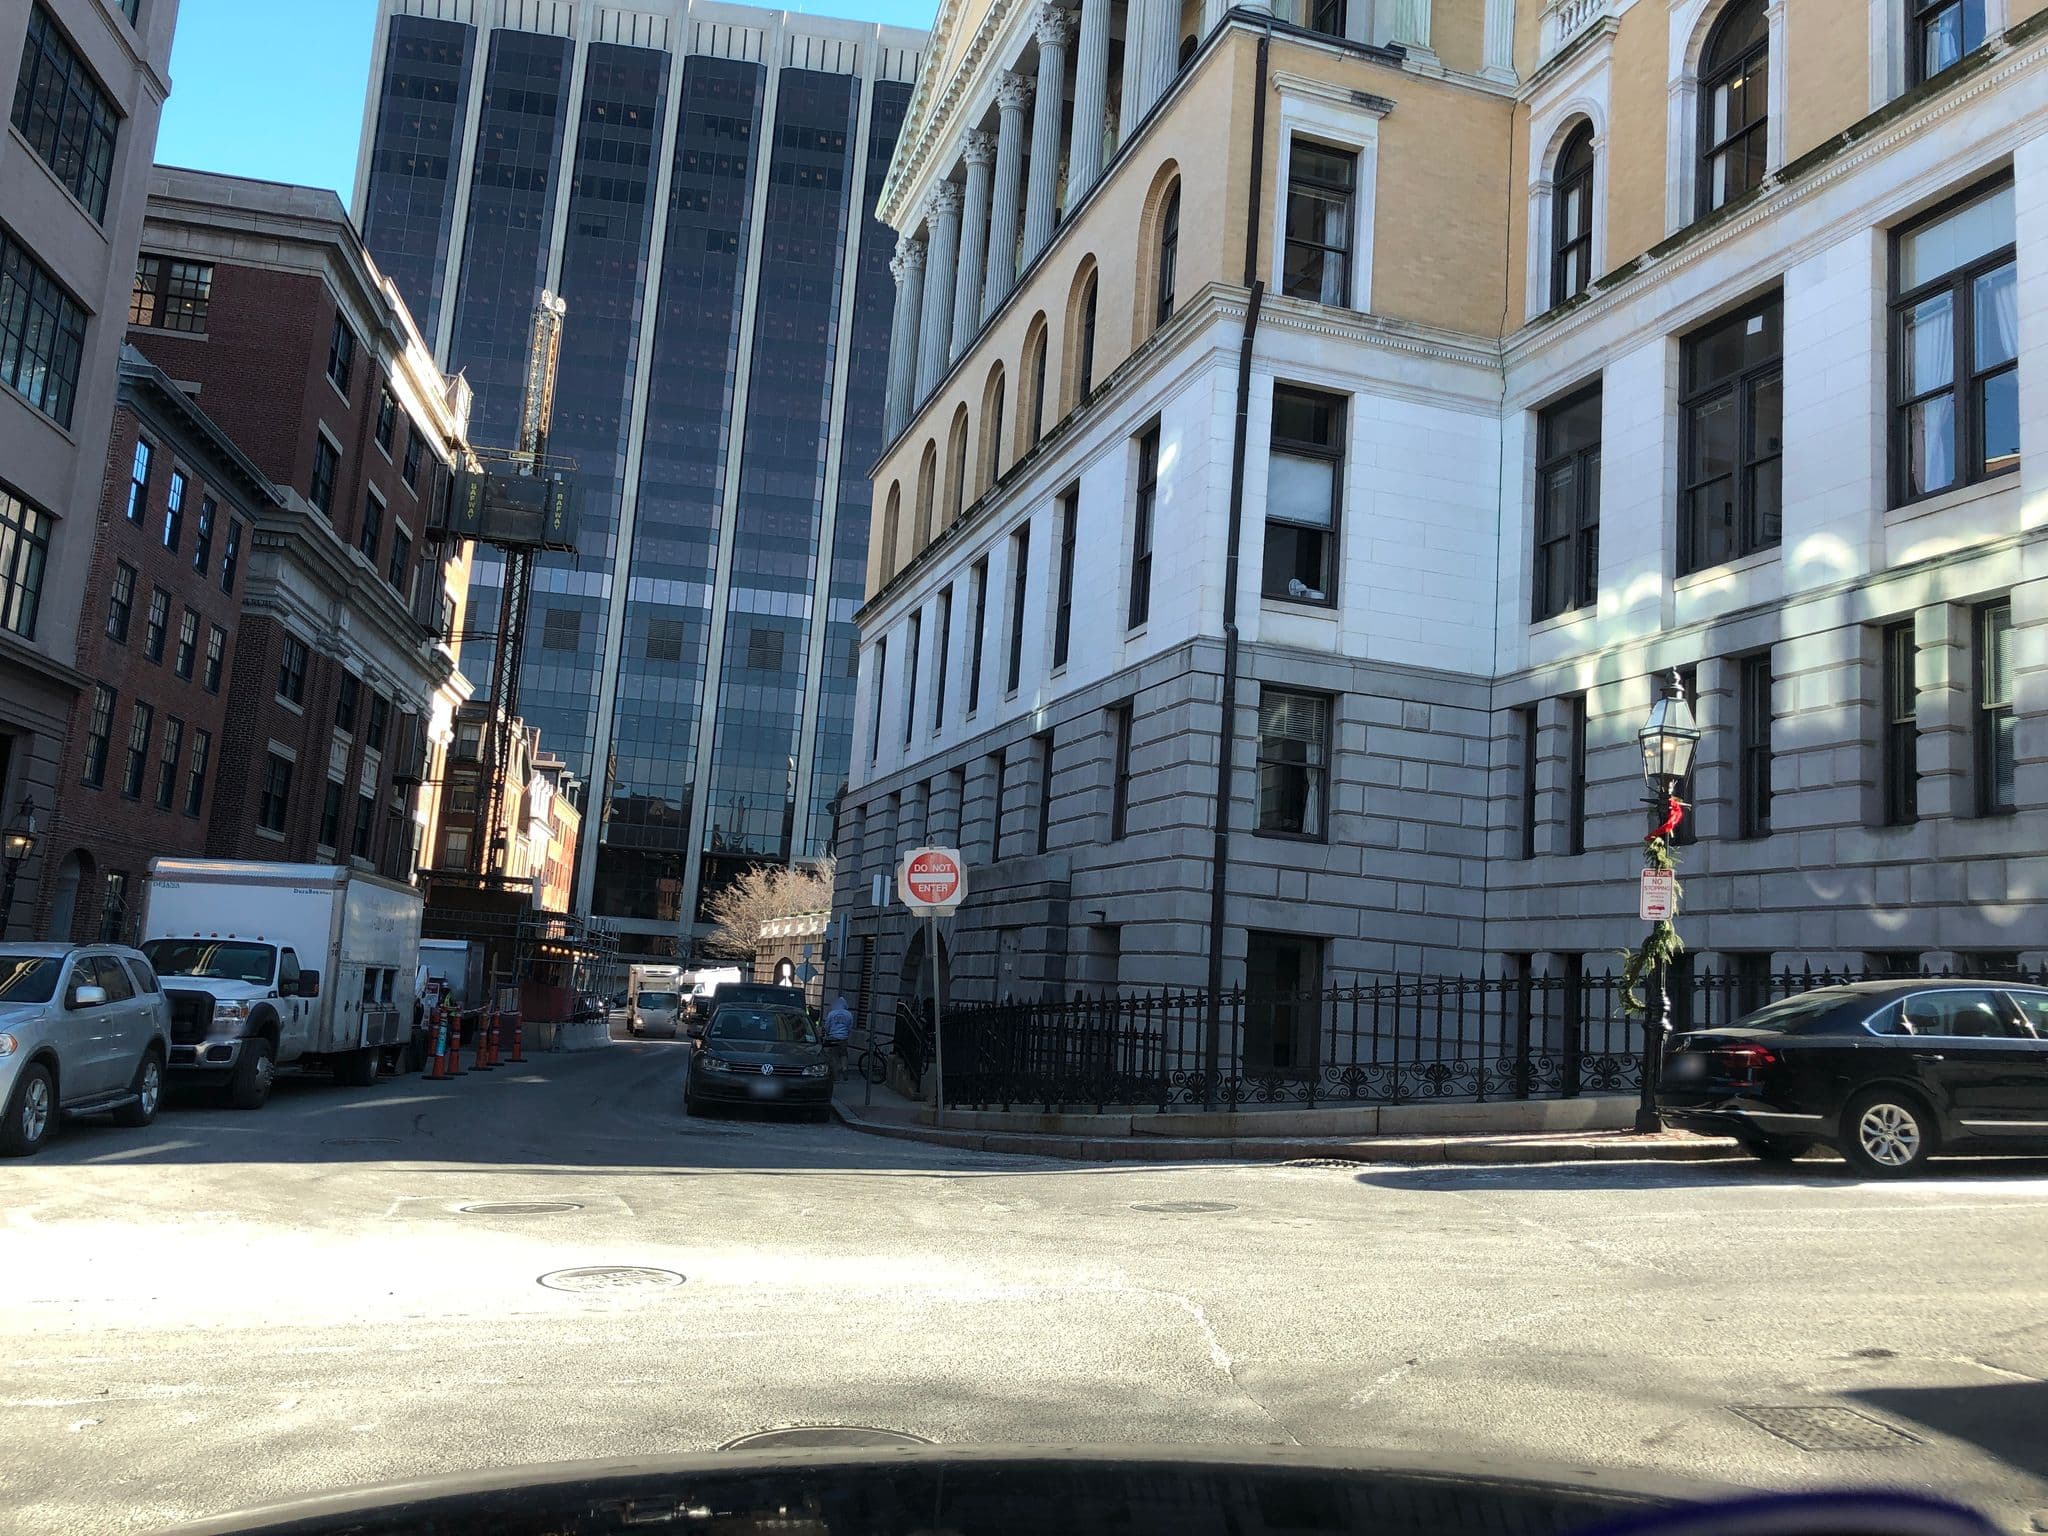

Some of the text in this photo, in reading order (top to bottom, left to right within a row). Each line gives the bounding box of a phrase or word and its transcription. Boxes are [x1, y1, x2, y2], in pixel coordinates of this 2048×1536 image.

[914, 863, 951, 872] DO NOT
[918, 884, 948, 892] ENTER
